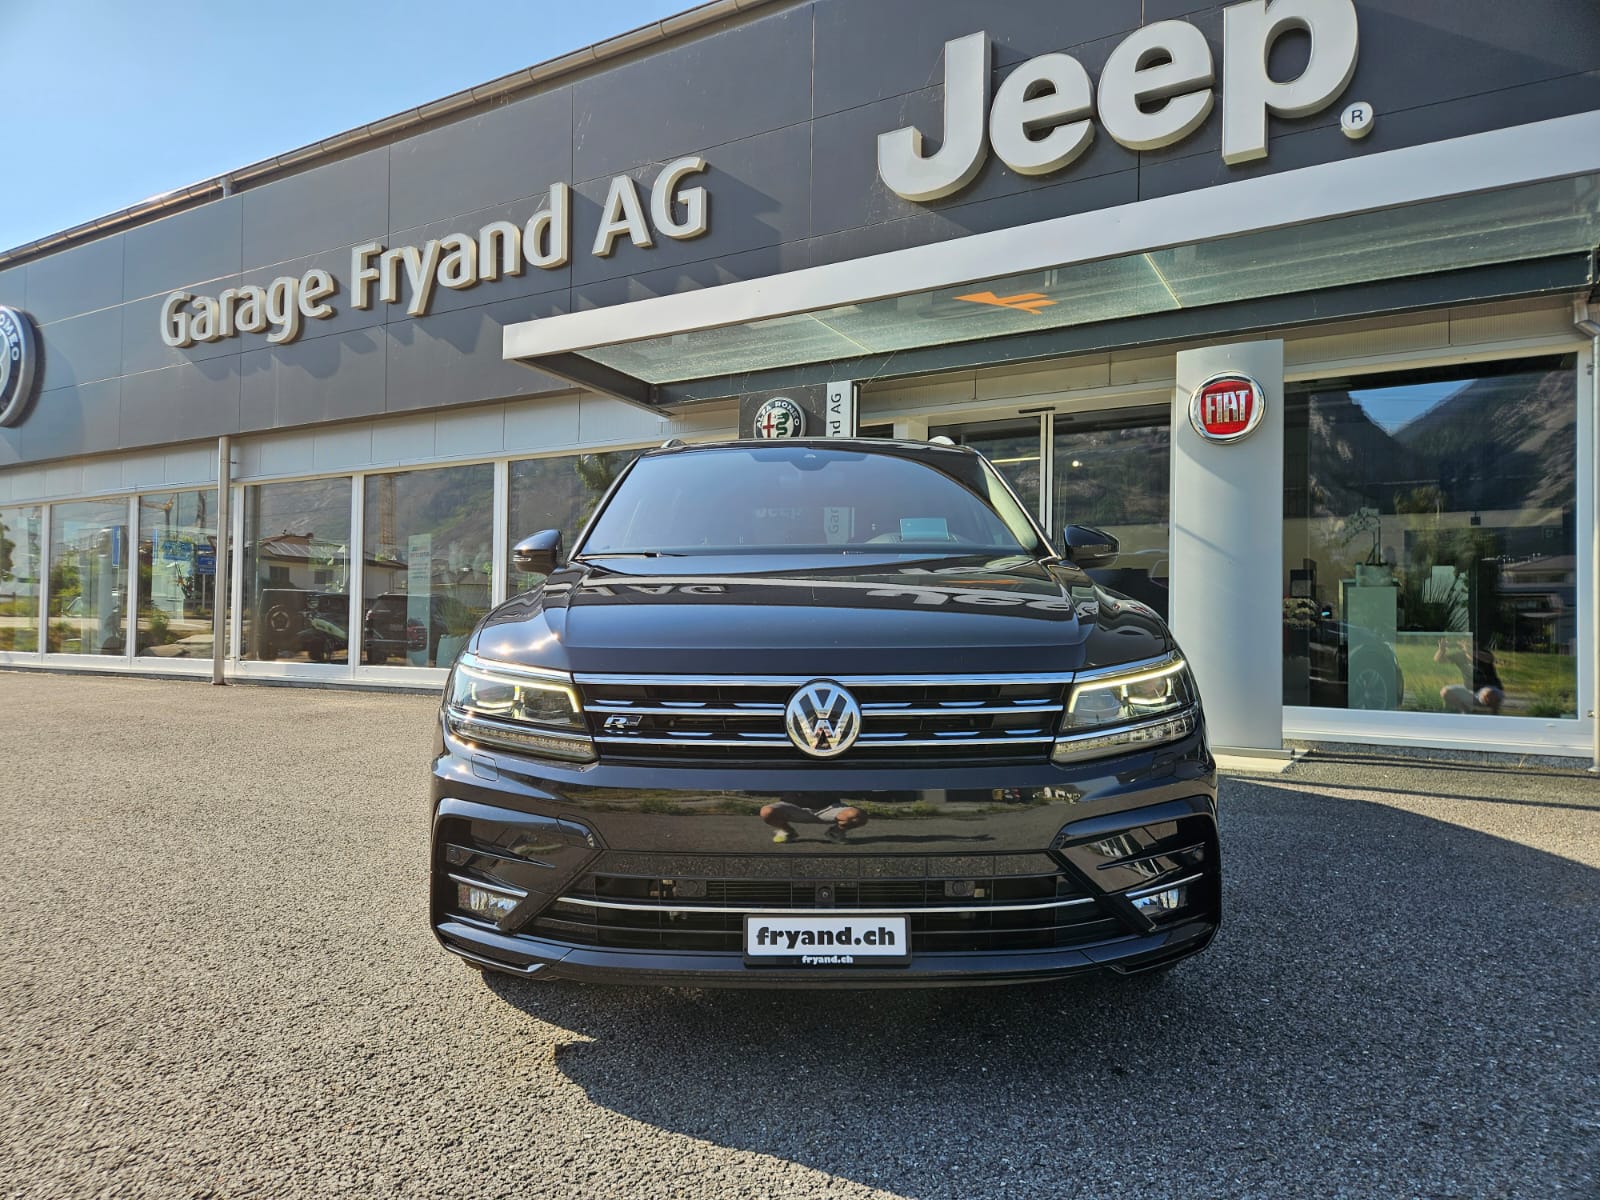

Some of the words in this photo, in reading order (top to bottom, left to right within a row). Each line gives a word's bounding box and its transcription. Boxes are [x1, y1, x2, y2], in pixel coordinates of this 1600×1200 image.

[877, 0, 1359, 201] Jeep
[160, 269, 335, 347] Garage
[350, 182, 569, 316] Fryand
[592, 156, 707, 257] AG
[830, 393, 842, 414] AG
[1206, 389, 1250, 425] FIAT
[756, 926, 896, 949] fryand.ch
[802, 955, 854, 965] fryand.ch
